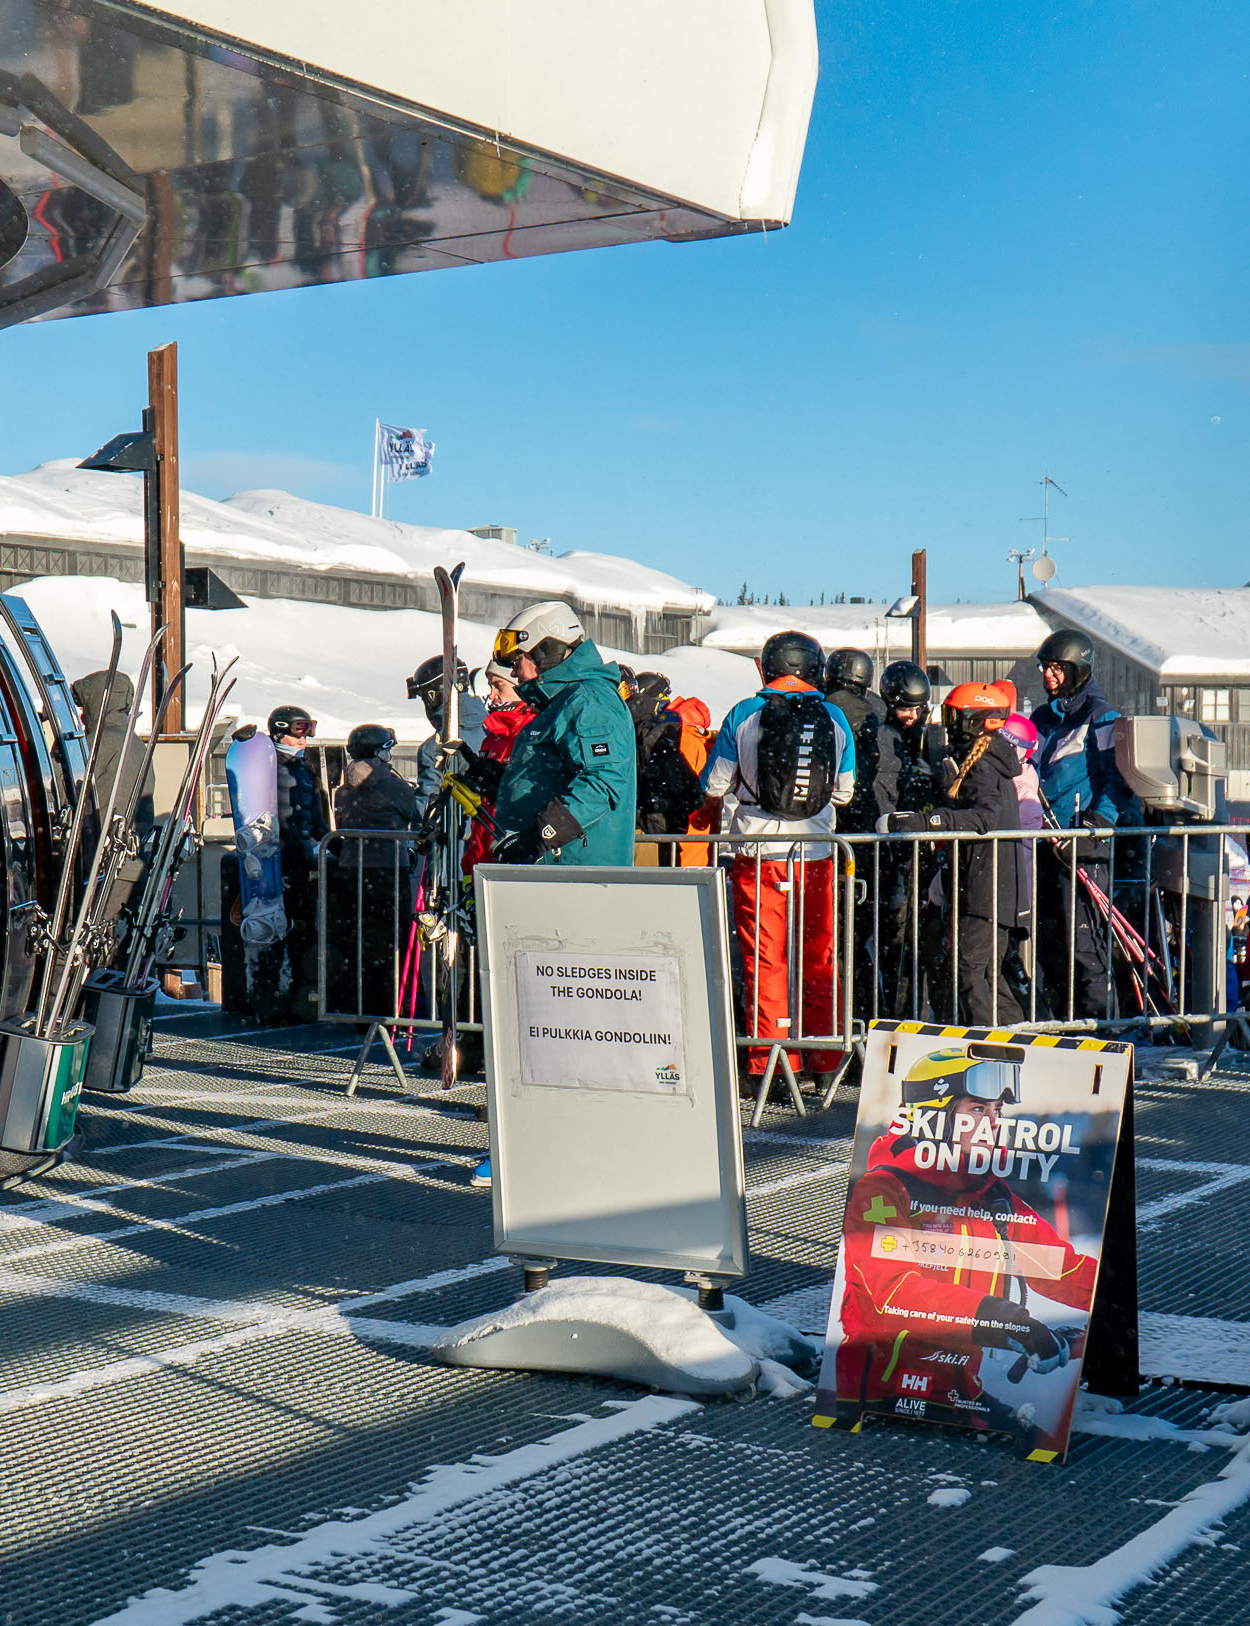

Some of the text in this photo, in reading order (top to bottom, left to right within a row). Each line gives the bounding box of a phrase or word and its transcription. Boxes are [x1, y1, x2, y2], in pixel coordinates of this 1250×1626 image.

[536, 965, 657, 982] NO SLEDGES INSIDE
[550, 986, 642, 1001] THE GONDOLA!
[529, 1026, 672, 1045] EI PULKKIA GONDOLIIN!
[655, 1070, 680, 1081] YLLÄS
[889, 1106, 1081, 1155] SKI PATROL
[913, 1140, 1060, 1183] ON DUTY
[909, 1200, 1038, 1225] If you need help, contact:
[884, 1305, 1031, 1333] Taking care of your safety on the slopes
[938, 1353, 970, 1366] ski.fi
[901, 1373, 928, 1392] HH
[895, 1398, 927, 1411] ALIVE
